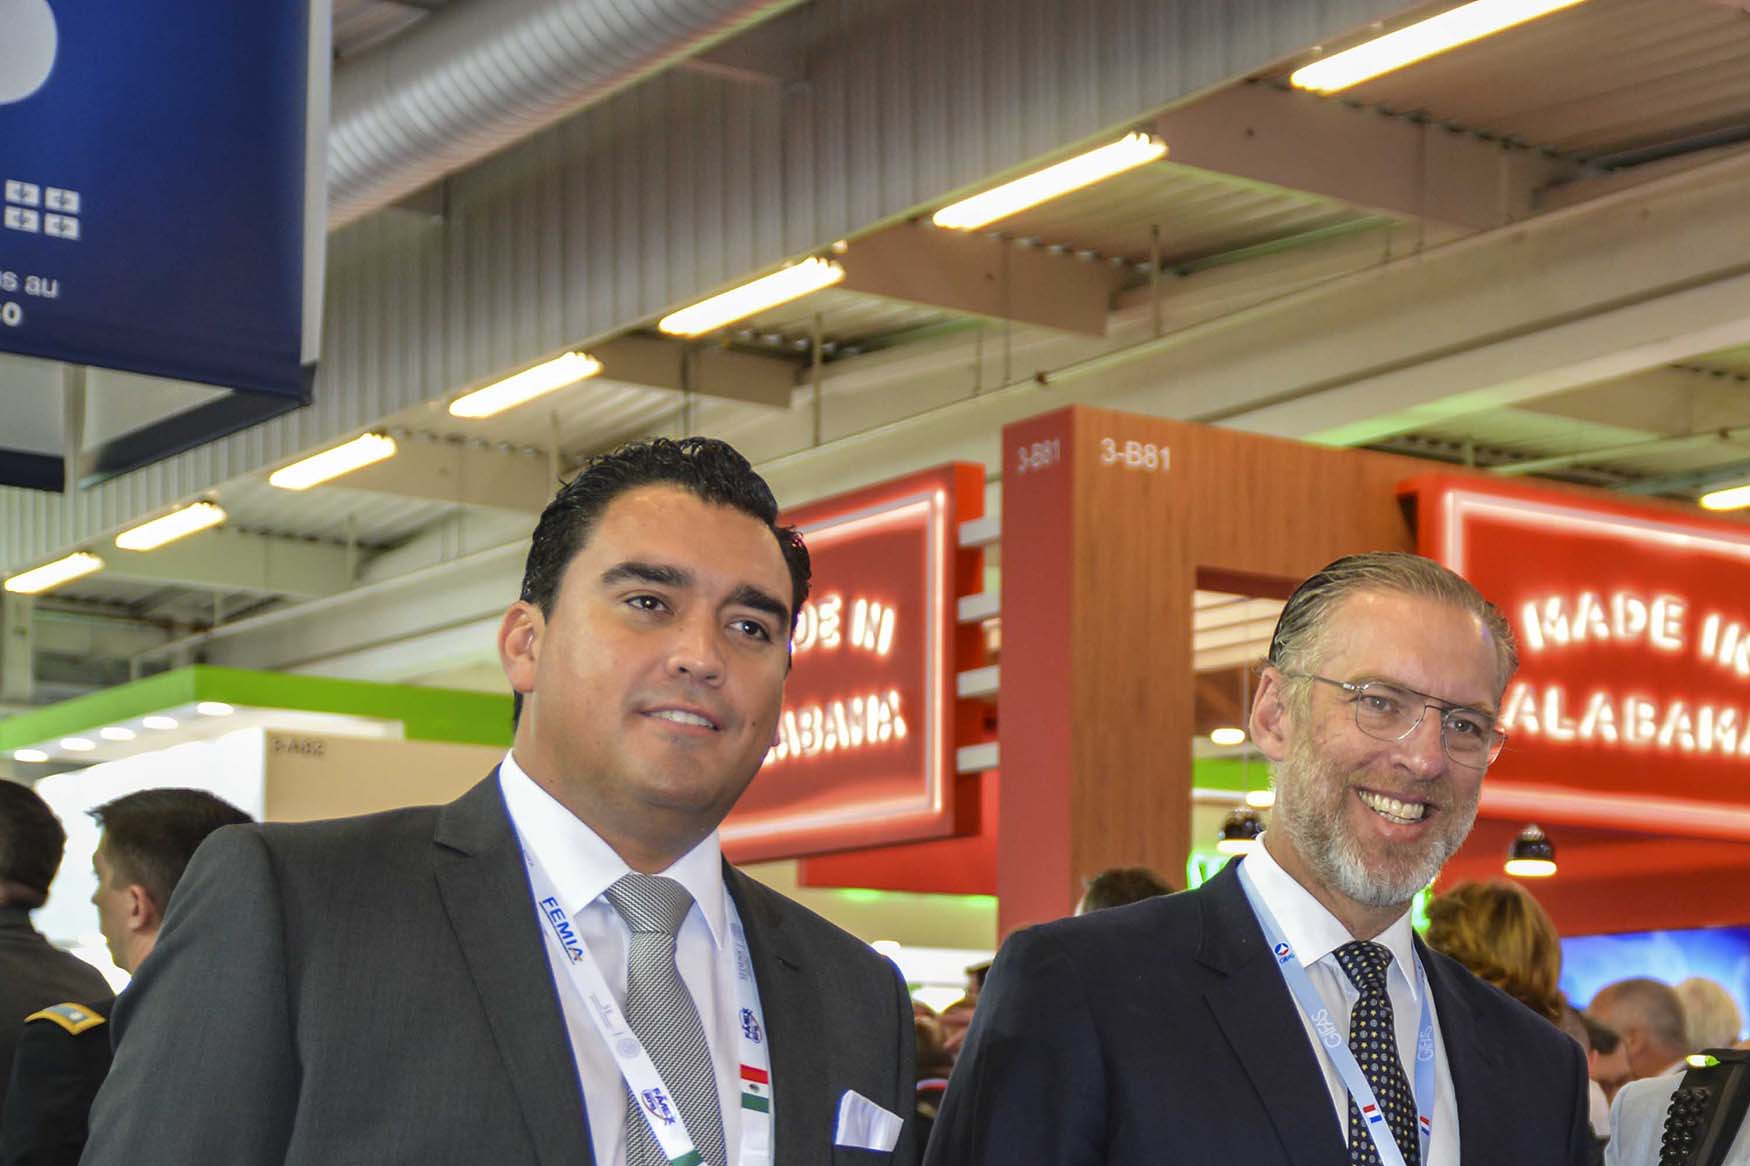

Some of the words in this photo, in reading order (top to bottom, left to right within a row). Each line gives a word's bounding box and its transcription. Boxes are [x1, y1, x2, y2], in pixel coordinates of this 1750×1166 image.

[1101, 437, 1171, 471] 3-B81
[851, 597, 896, 656] IN
[1522, 591, 1686, 651] MADE
[542, 896, 585, 962] FEMIA
[1312, 1008, 1341, 1048] GIFAS
